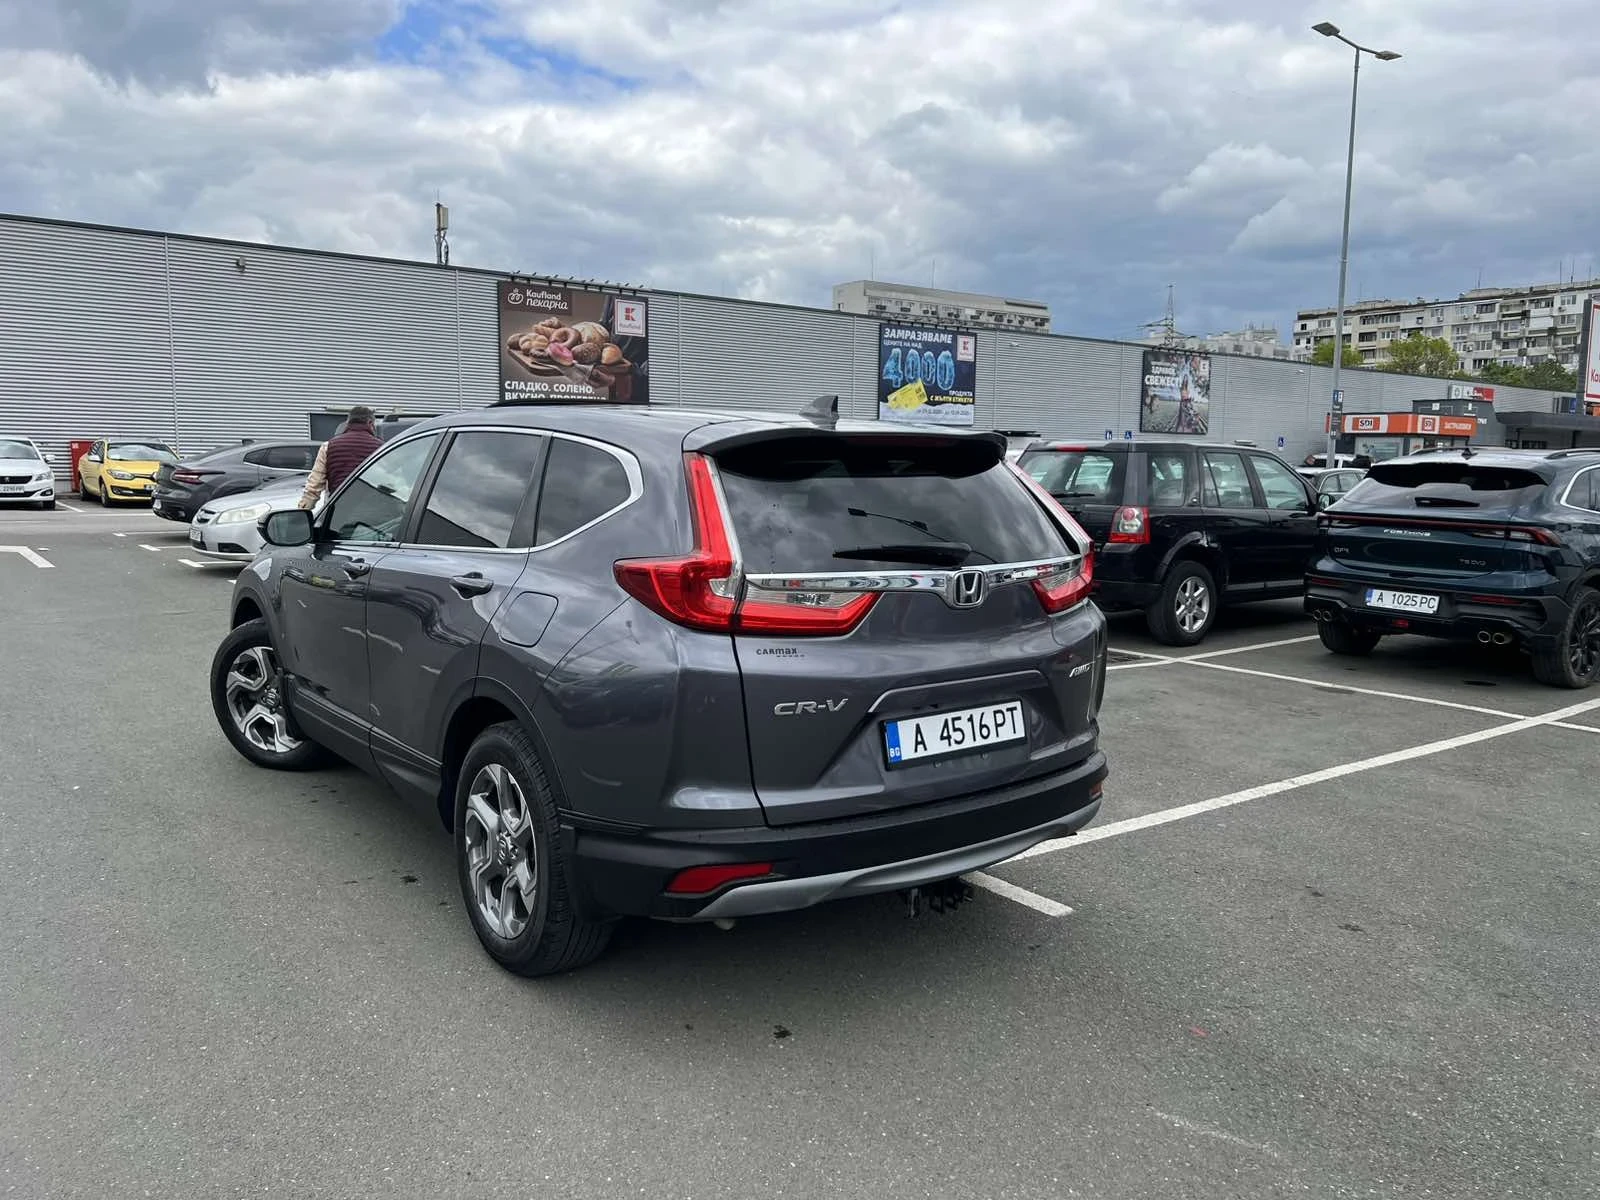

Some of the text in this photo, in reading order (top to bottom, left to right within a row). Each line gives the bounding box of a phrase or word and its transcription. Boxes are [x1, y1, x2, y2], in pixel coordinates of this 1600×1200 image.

[526, 289, 562, 300] Kaufland
[526, 298, 568, 310] пекарна
[883, 327, 953, 344] ЗАМРАЗЯВАМЕ
[882, 347, 955, 391] 4000
[504, 381, 595, 394] СЛАДКО. СОЛЕНО.
[1377, 591, 1384, 603] A
[773, 698, 848, 717] CR-V
[913, 722, 928, 754] A
